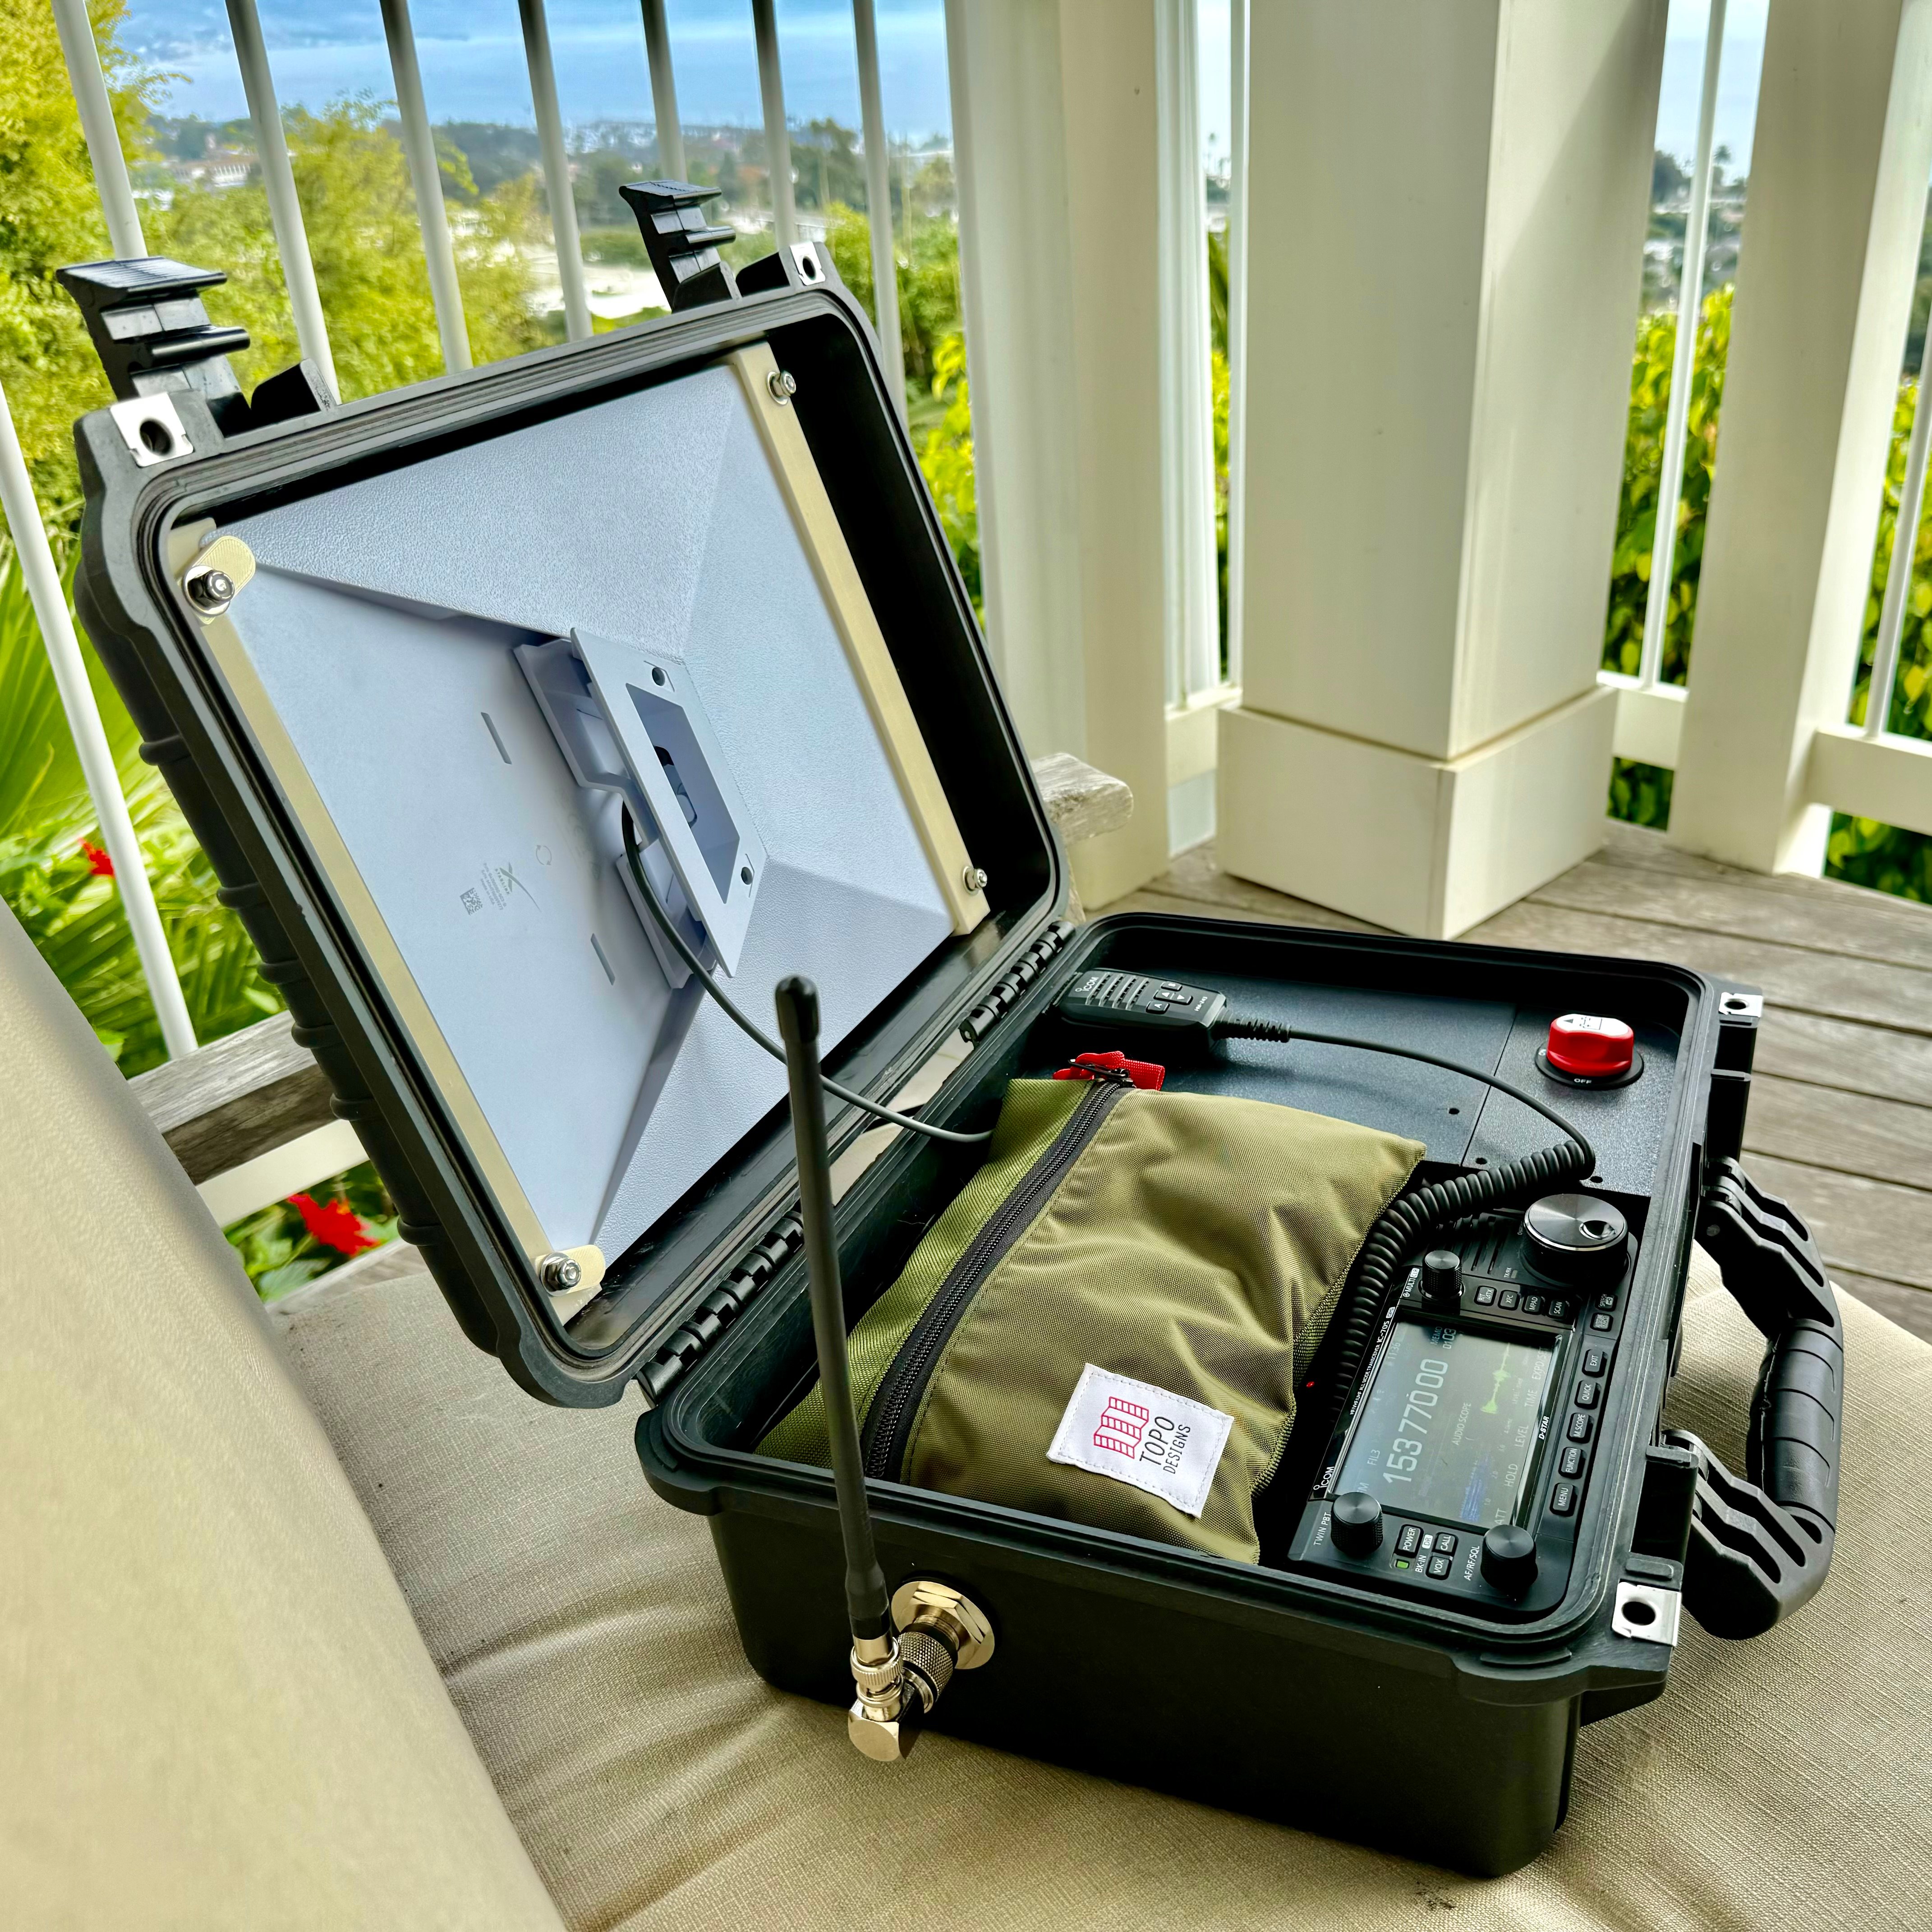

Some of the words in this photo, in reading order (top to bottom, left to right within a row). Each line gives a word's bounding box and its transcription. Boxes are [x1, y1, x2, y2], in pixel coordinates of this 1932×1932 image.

[1405, 1278, 1416, 1293] MULTI
[1411, 1269, 1419, 1278] CLR
[1505, 1294, 1513, 1304] XFC
[1529, 1297, 1538, 1311] MPAD
[1554, 1302, 1562, 1314] SCAN
[1376, 1321, 1390, 1343] IC-705
[1430, 1326, 1443, 1345] MEMO
[1590, 1355, 1599, 1366] EXIT
[1582, 1384, 1592, 1400] QUICK
[1452, 1423, 1465, 1446] AUDIO
[1459, 1402, 1472, 1423] SCOPE
[1573, 1414, 1585, 1437] M.SCOPE
[1140, 1416, 1175, 1466] TOPO
[1163, 1424, 1191, 1474] DESIGNS
[1367, 1449, 1380, 1465] FIL3
[1494, 1508, 1507, 1525] ATT
[1504, 1463, 1518, 1487] HOLD
[1514, 1425, 1529, 1448] LEVEL
[1524, 1389, 1537, 1407] TIME
[1565, 1448, 1578, 1473] FUNCTION
[1558, 1487, 1569, 1506] MENU
[1313, 1527, 1327, 1546] TWIN
[1321, 1512, 1331, 1526] PBT
[1403, 1527, 1417, 1551] POWER
[1424, 1536, 1432, 1546] DR
[1440, 1535, 1451, 1550] CALL
[1433, 1559, 1444, 1573] VOX
[1464, 1546, 1480, 1581] AF/RF/SQL
